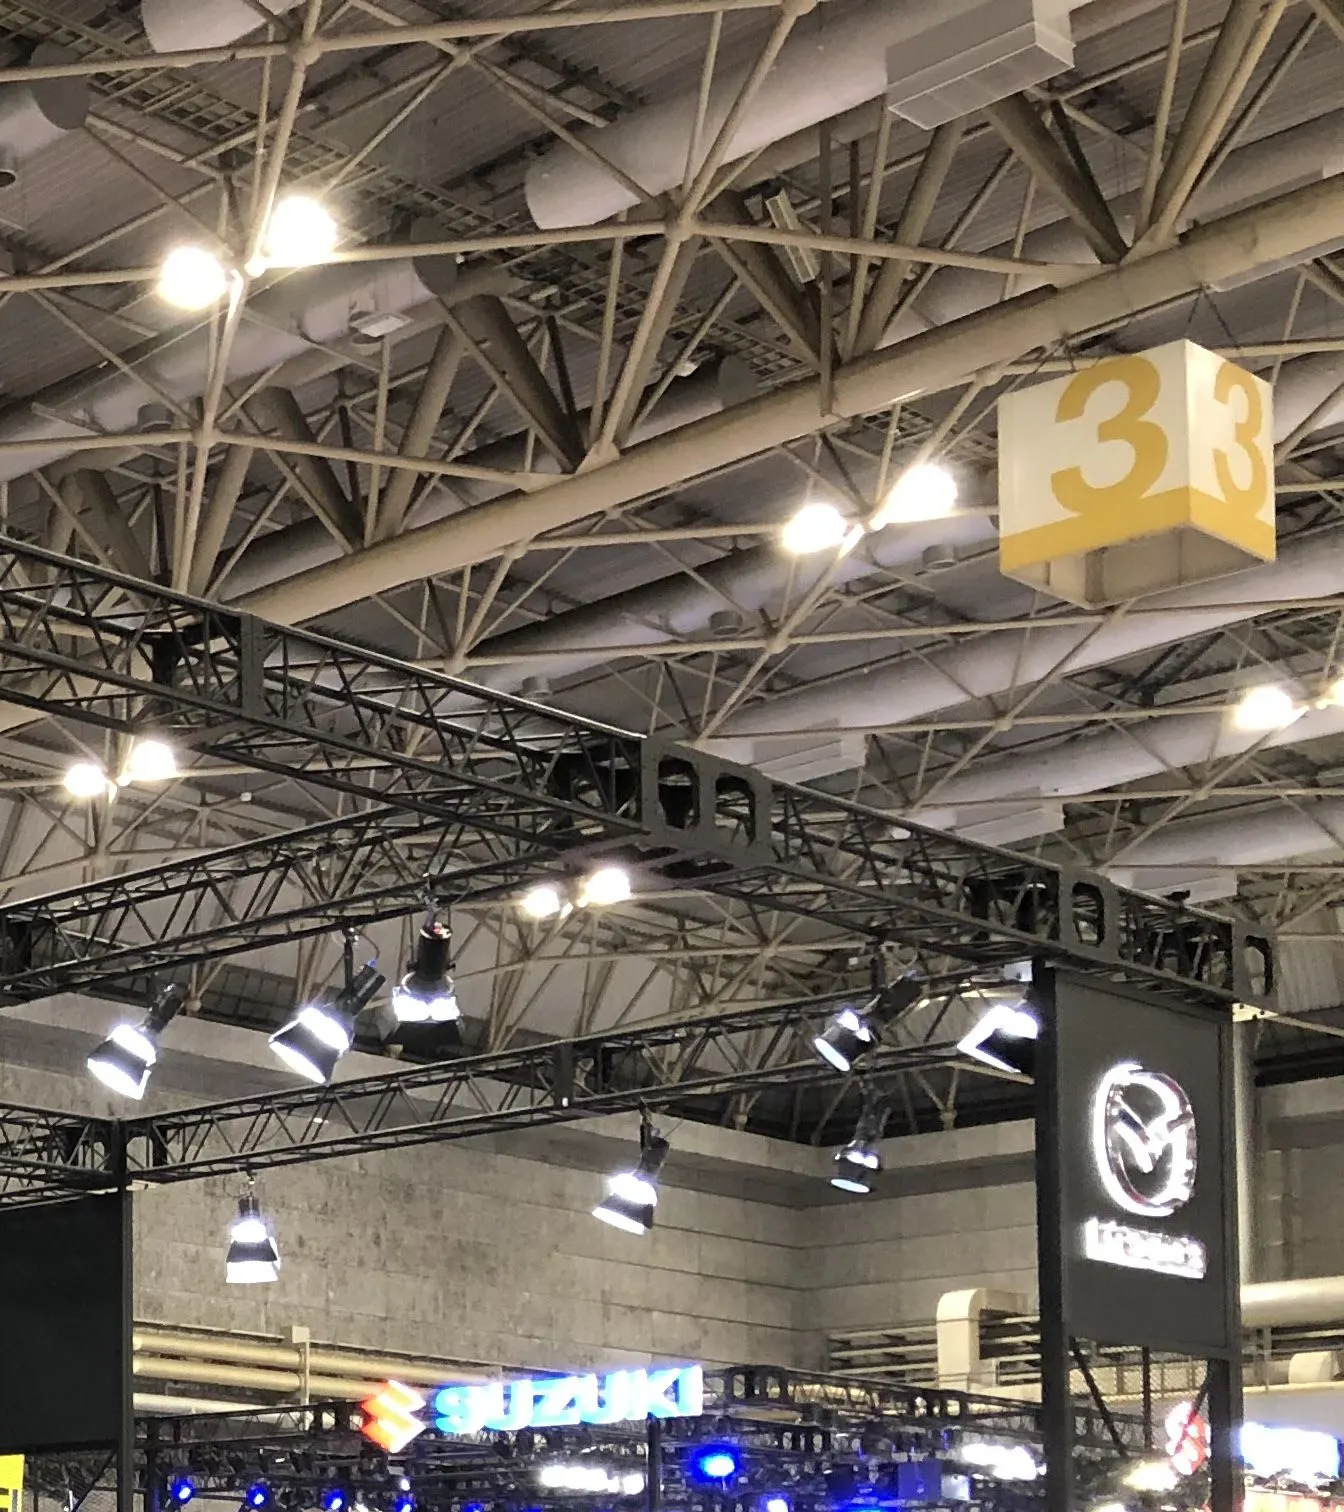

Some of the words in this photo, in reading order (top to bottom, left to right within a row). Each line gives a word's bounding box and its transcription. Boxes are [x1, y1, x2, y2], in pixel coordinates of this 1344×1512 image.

[1051, 356, 1169, 520] 3
[1212, 361, 1268, 518] 3
[434, 1365, 704, 1435] SUZUKI
